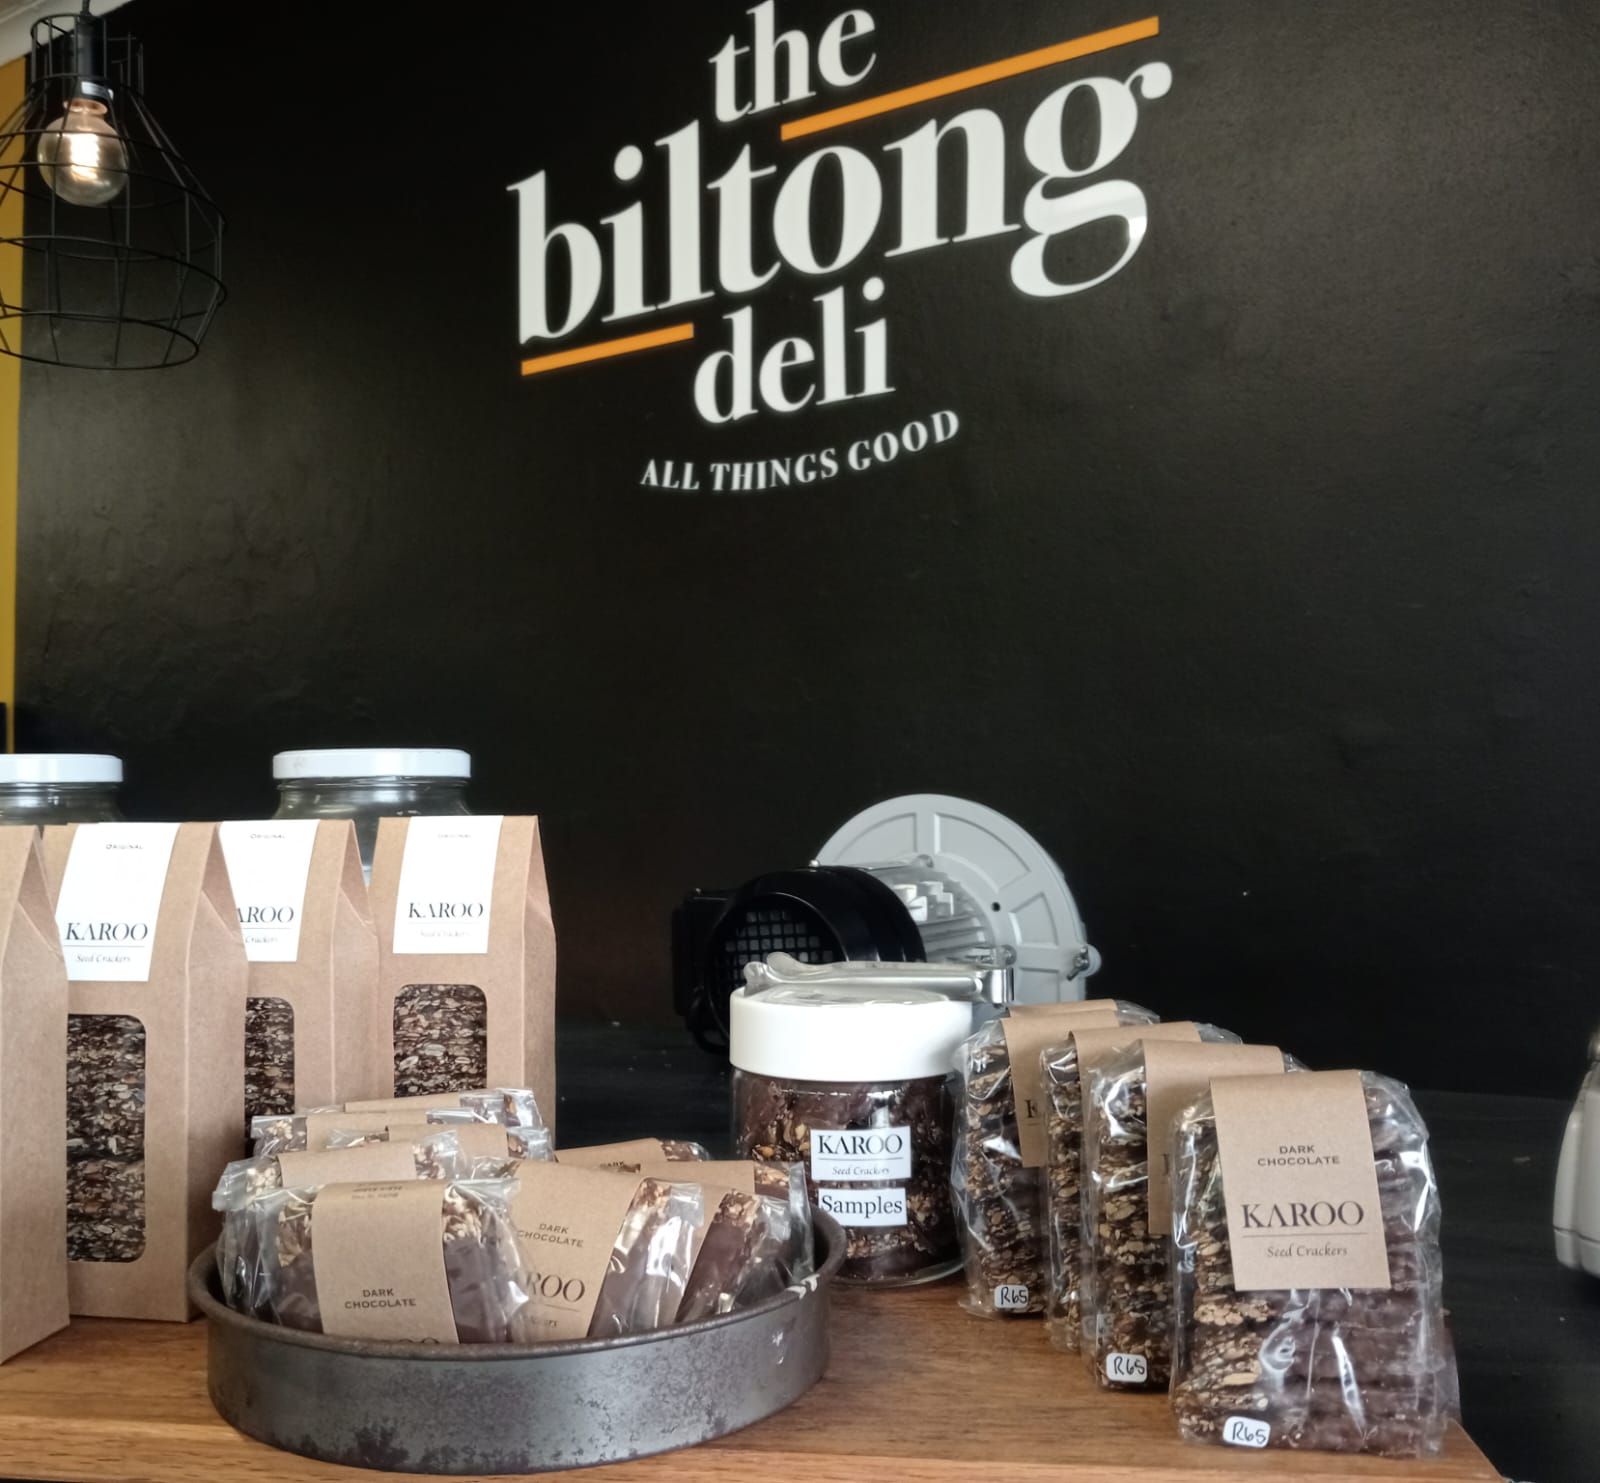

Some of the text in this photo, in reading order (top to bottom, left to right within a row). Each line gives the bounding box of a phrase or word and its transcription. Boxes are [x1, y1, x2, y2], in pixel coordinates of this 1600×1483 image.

[708, 0, 876, 122] the
[506, 61, 1172, 345] biltong
[694, 276, 895, 424] deli
[640, 410, 959, 491] ALL THINGS GOOD
[237, 906, 294, 923] AROO
[408, 902, 484, 919] KAROO
[65, 922, 148, 941] KAROO
[818, 1133, 903, 1155] KAROO
[1279, 1145, 1315, 1154] DARK
[832, 1165, 851, 1176] Seed
[1257, 1156, 1340, 1166] CHOCOLATE
[821, 1195, 903, 1219] Samples
[1241, 1201, 1364, 1228] KAROO
[539, 1223, 570, 1235] DARK
[517, 1230, 584, 1248] CHOCOLATE
[1267, 1241, 1348, 1258] Seed Crackers
[362, 1288, 394, 1298] DARK
[1000, 1286, 1027, 1305] R65
[344, 1298, 417, 1309] CHOCOLATE
[1113, 1356, 1145, 1375] R65
[1232, 1421, 1266, 1445] R65
